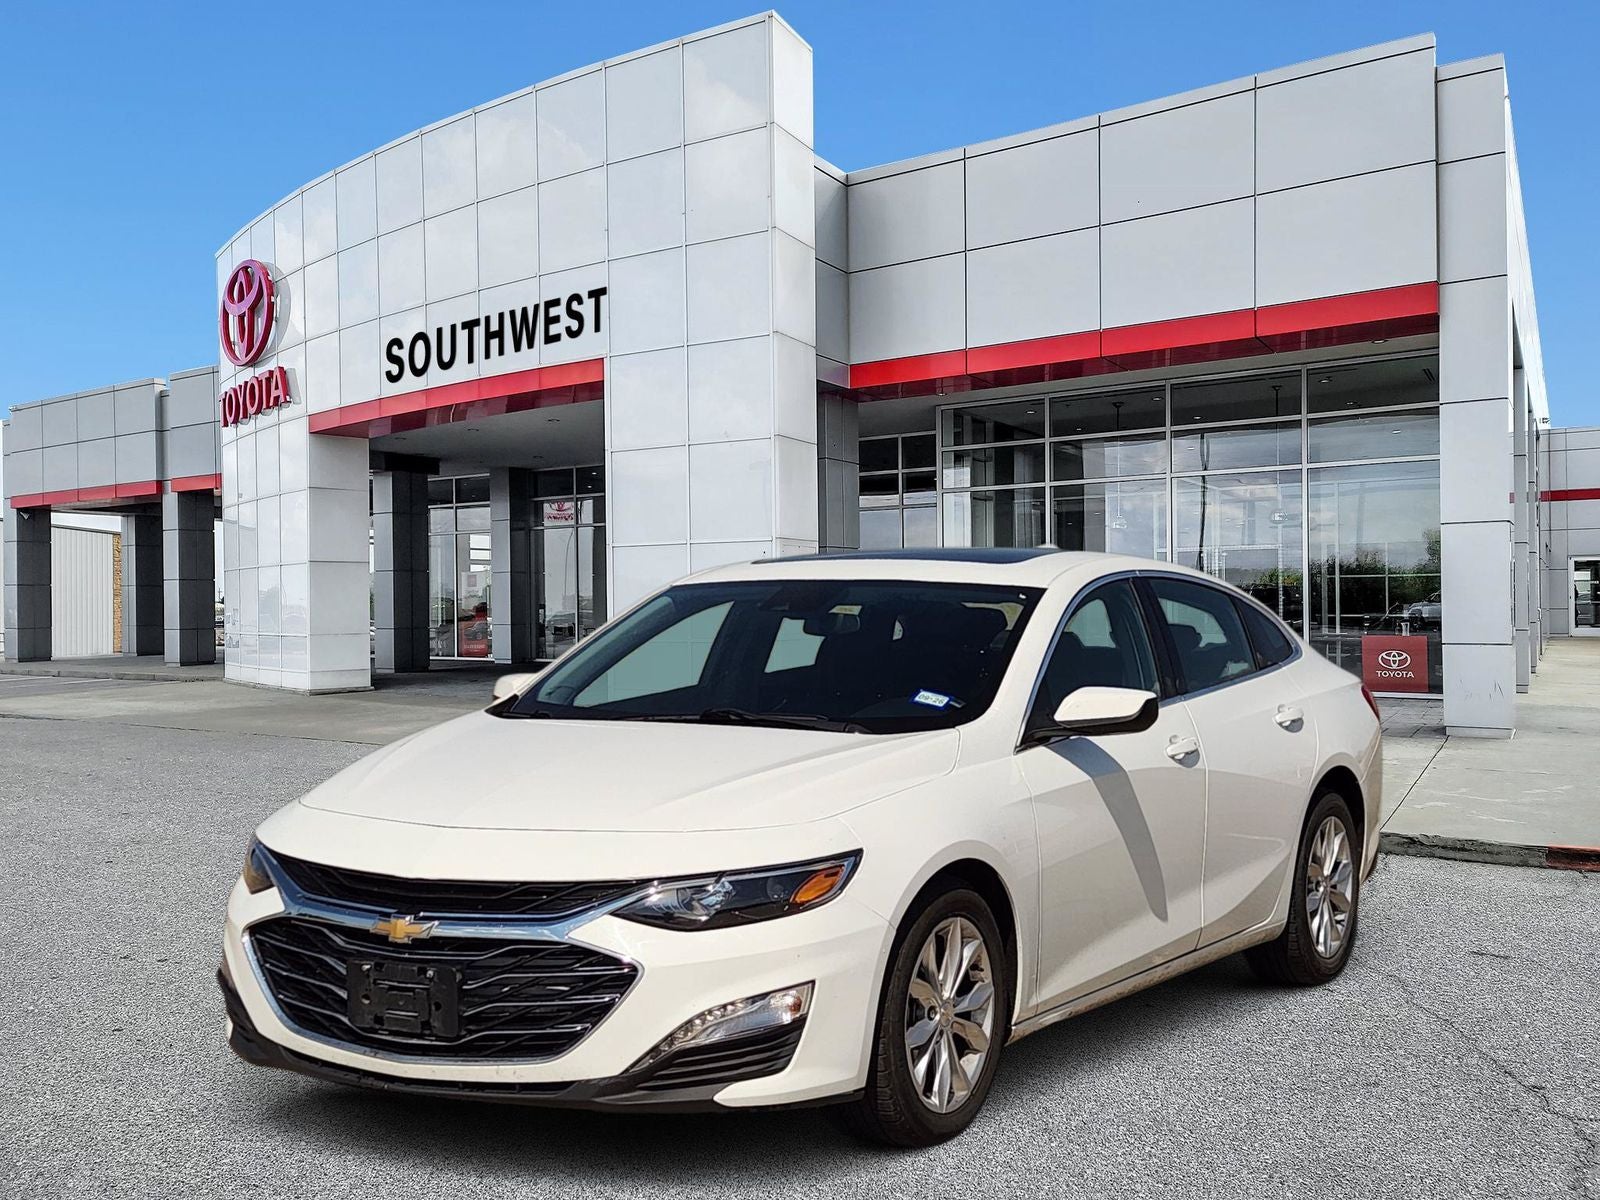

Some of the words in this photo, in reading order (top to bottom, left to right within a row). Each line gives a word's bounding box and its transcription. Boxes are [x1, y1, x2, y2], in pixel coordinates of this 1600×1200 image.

[385, 286, 608, 383] SOUTHWEST
[219, 366, 291, 428] TOYOTA
[1376, 670, 1415, 679] TOYOTA
